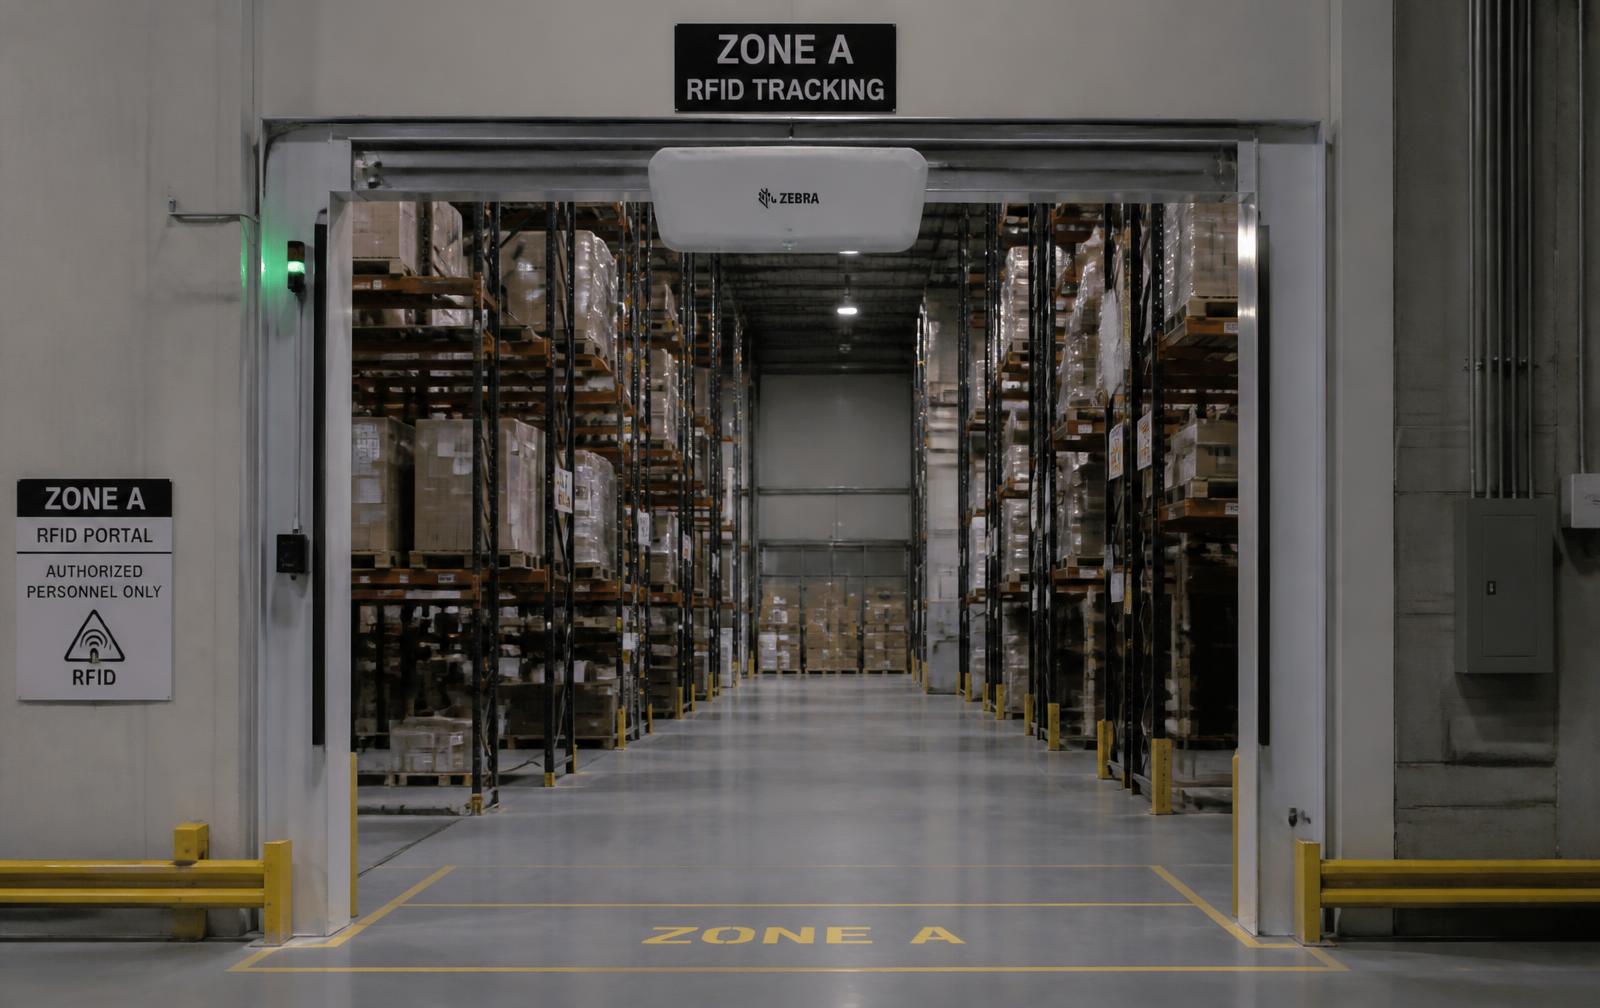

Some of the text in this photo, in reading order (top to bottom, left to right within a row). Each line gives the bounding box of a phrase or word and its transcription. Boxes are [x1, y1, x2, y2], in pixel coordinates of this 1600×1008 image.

[716, 33, 855, 65] ZONE A
[686, 78, 885, 101] RFID TRACKING
[779, 192, 820, 204] ZEBRA
[44, 486, 146, 511] ZONE A
[36, 527, 153, 543] RFID PORTAL
[45, 564, 143, 578] AUTHORIZED
[27, 585, 162, 599] PERSONNEL ONLY
[72, 669, 116, 686] RFID
[641, 926, 966, 945] ZONE A
